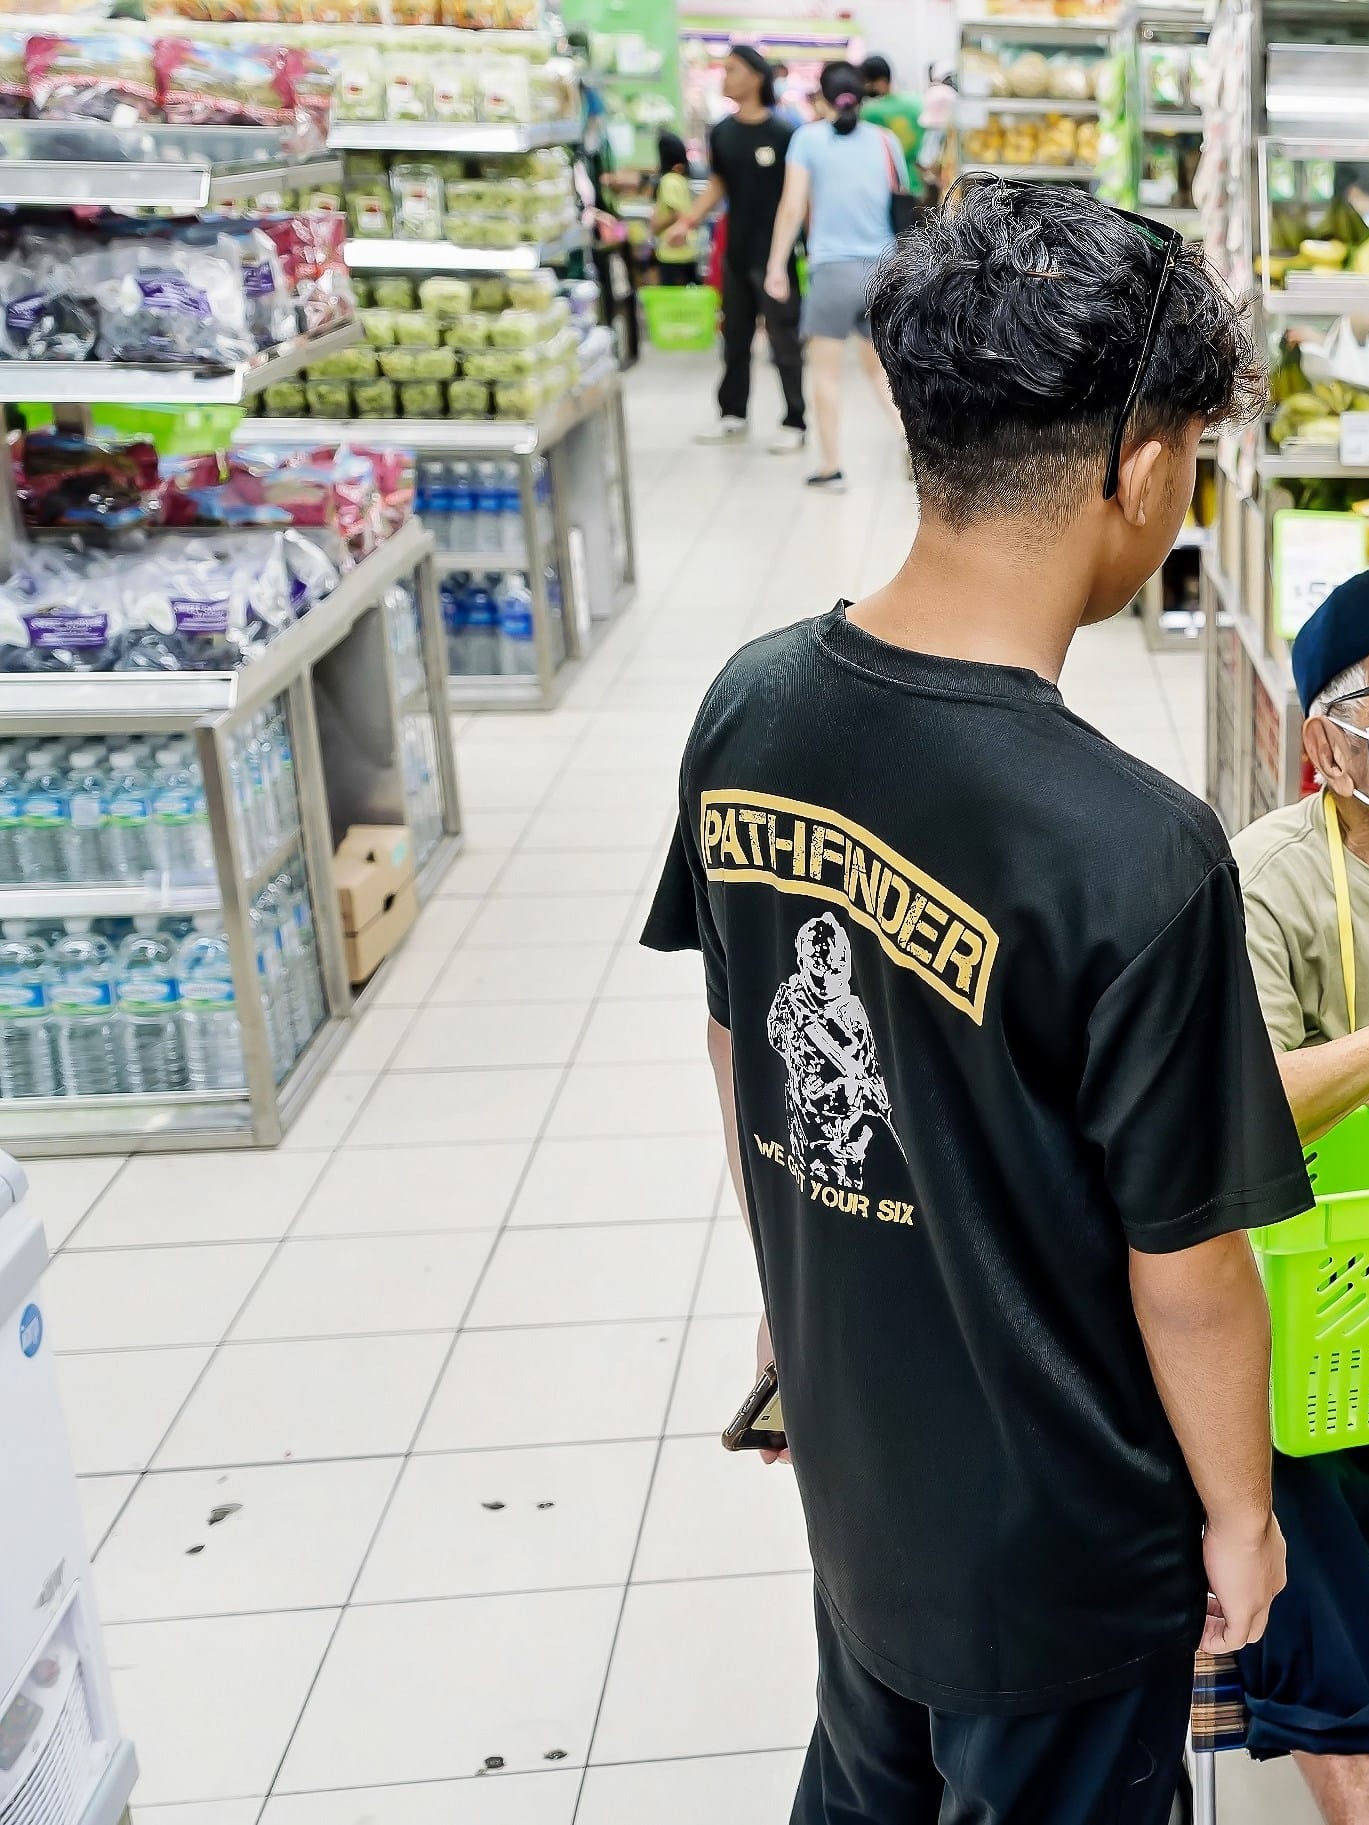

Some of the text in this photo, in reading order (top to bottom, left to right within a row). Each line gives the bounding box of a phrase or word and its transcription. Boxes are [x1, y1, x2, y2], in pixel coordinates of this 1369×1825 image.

[705, 809, 983, 994] PATHFINDER
[753, 1133, 786, 1167] WE
[810, 1180, 869, 1219] YOUR
[876, 1199, 914, 1226] SIX
